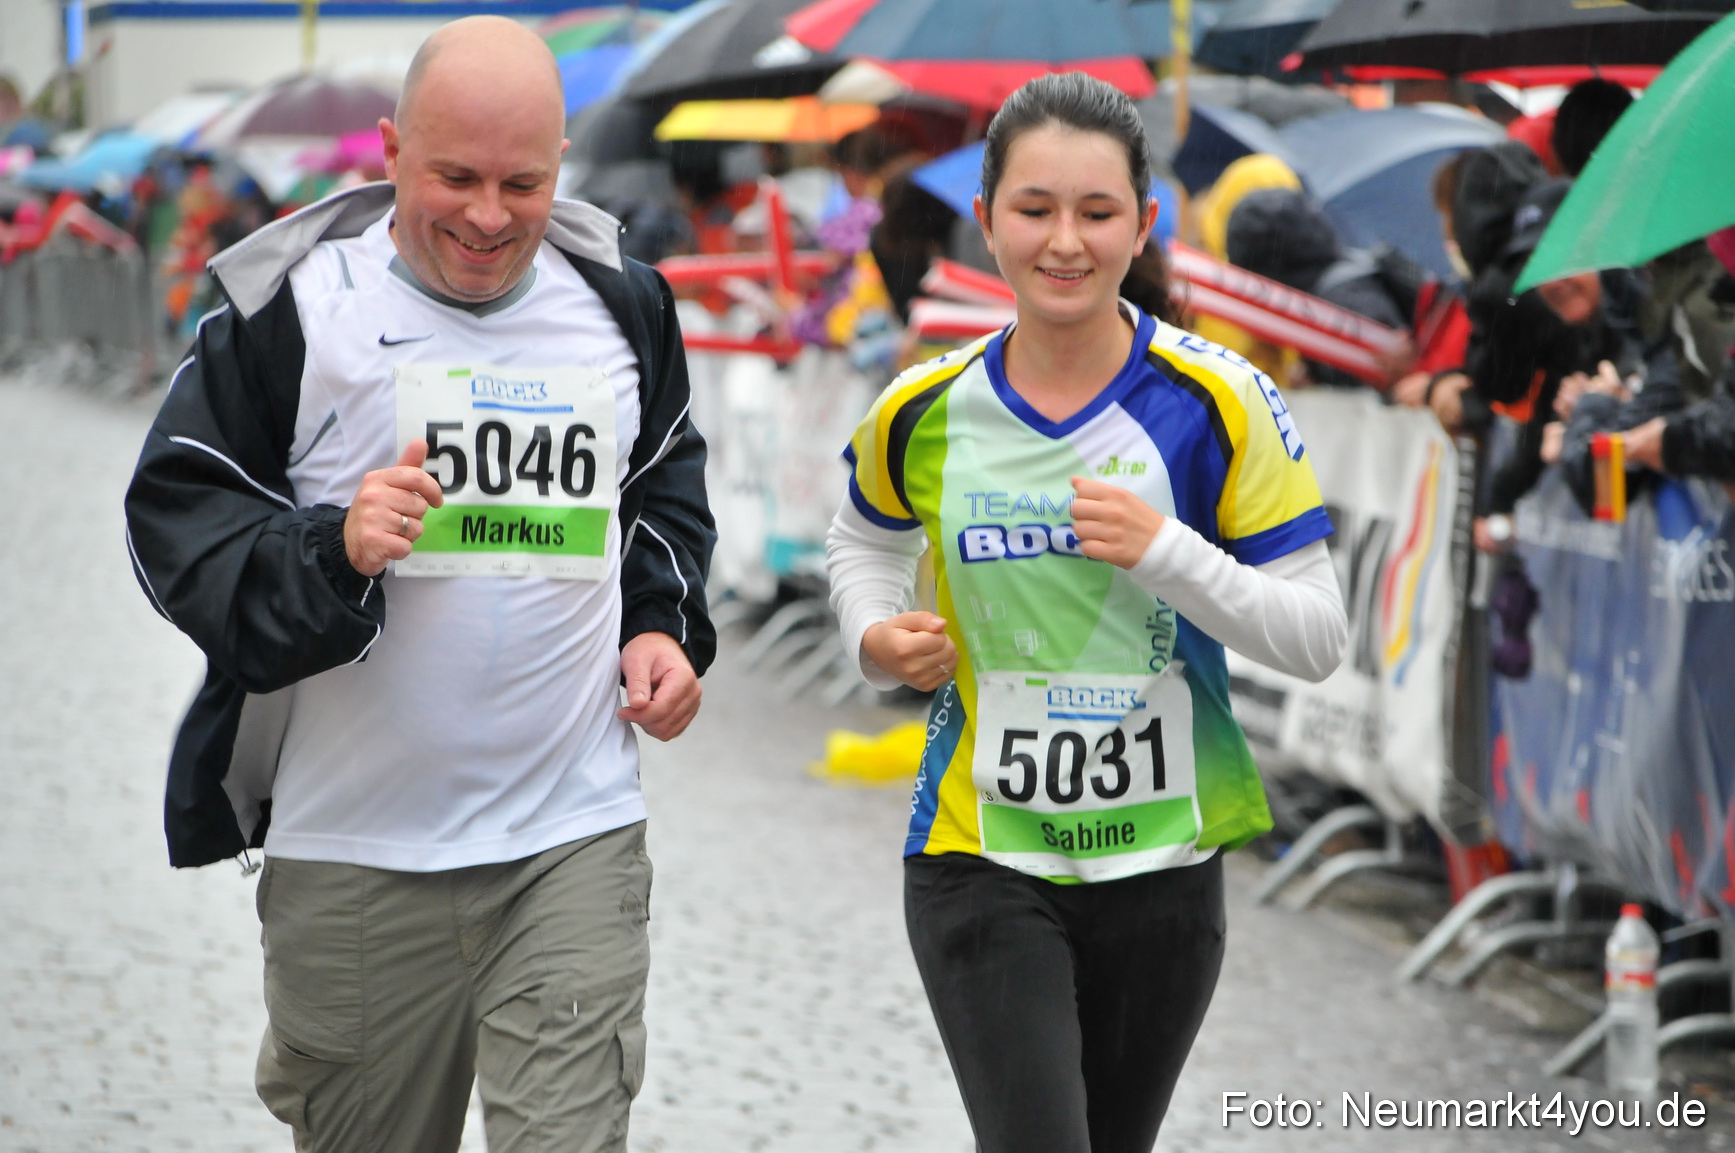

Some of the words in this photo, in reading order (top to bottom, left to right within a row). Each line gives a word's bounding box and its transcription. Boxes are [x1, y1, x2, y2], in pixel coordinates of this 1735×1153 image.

[425, 420, 597, 498] 5046
[964, 491, 1074, 519] TEAM
[460, 514, 565, 547] Markus
[958, 522, 1088, 565] BOC
[1047, 685, 1140, 710] BOCK
[997, 716, 1167, 804] 5031
[1040, 819, 1136, 852] Sabine
